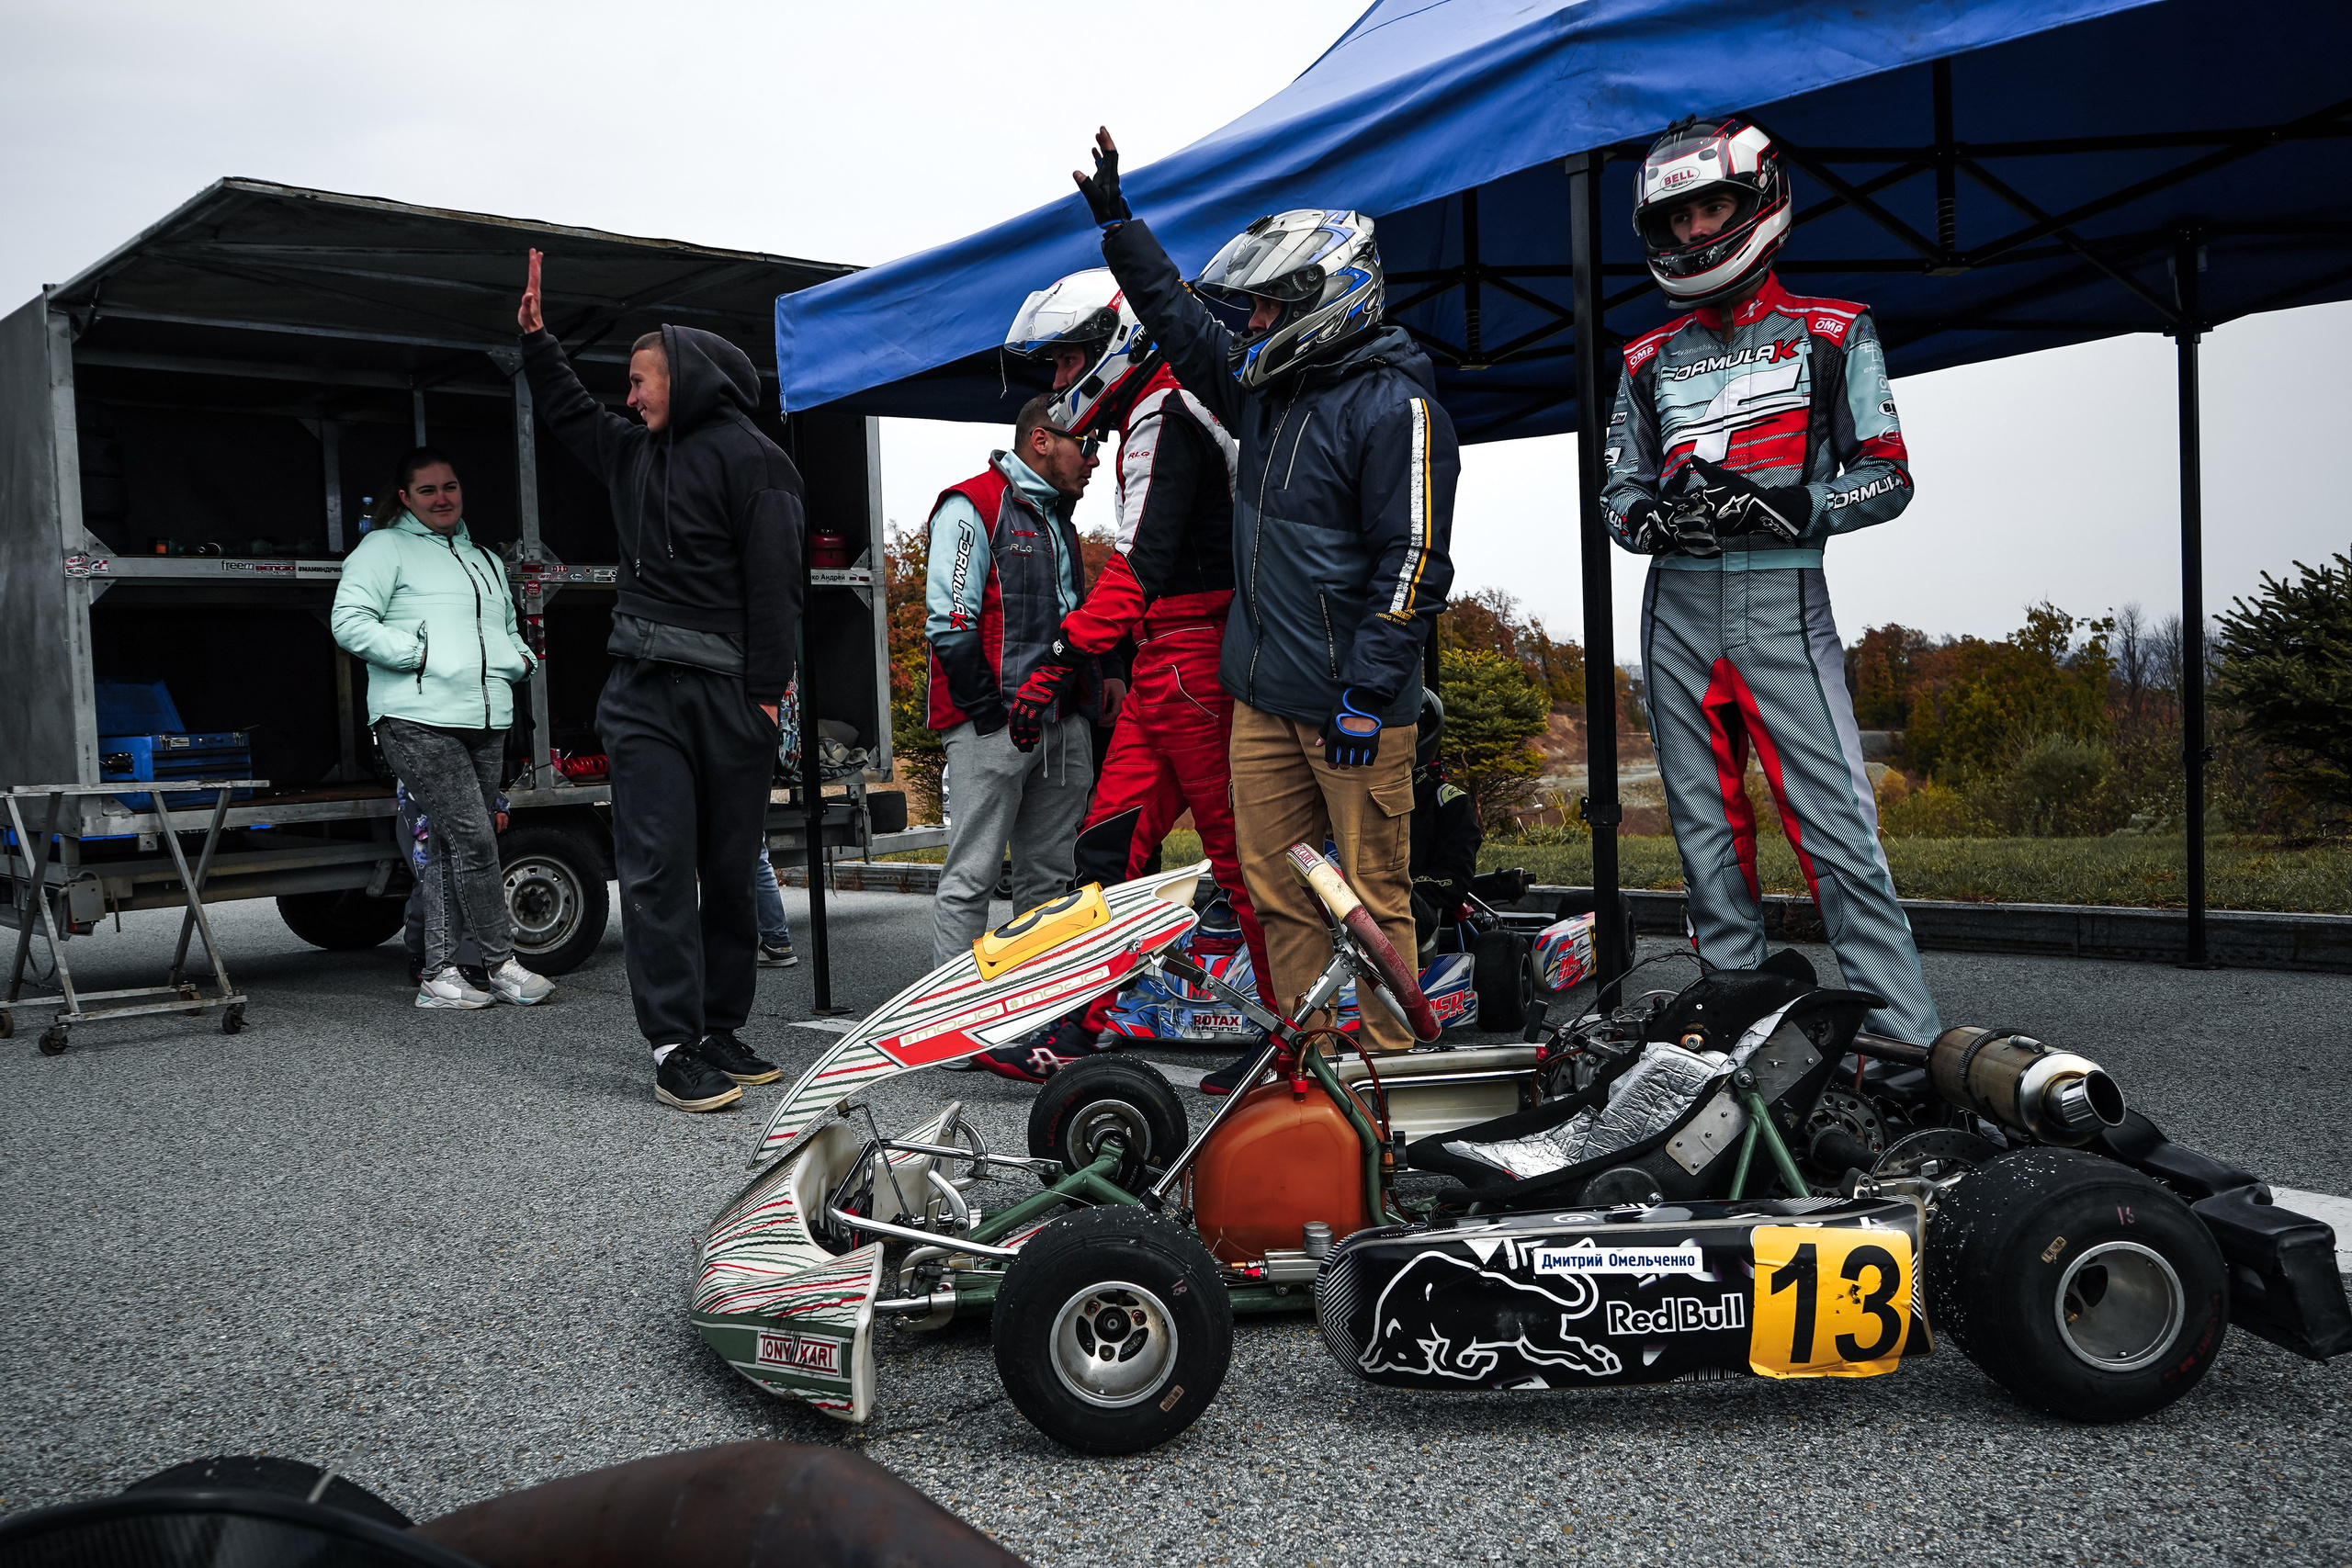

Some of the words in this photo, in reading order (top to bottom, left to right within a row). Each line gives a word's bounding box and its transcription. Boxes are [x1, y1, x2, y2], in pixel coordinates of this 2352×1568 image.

[1664, 170, 1694, 186] BELL
[1815, 319, 1844, 333] OMP
[1629, 345, 1655, 366] OMP
[1009, 543, 1034, 553] RLG
[820, 573, 846, 582] Андрей
[916, 1007, 999, 1041] MOJO
[1023, 969, 1104, 1005] MOJO
[1194, 1015, 1240, 1027] ROTAX
[1542, 1254, 1603, 1269] Дмитрий
[1609, 1254, 1695, 1268] Омельченко
[1770, 1243, 1902, 1364] 13
[759, 1334, 793, 1361] TONY
[798, 1338, 837, 1368] KART
